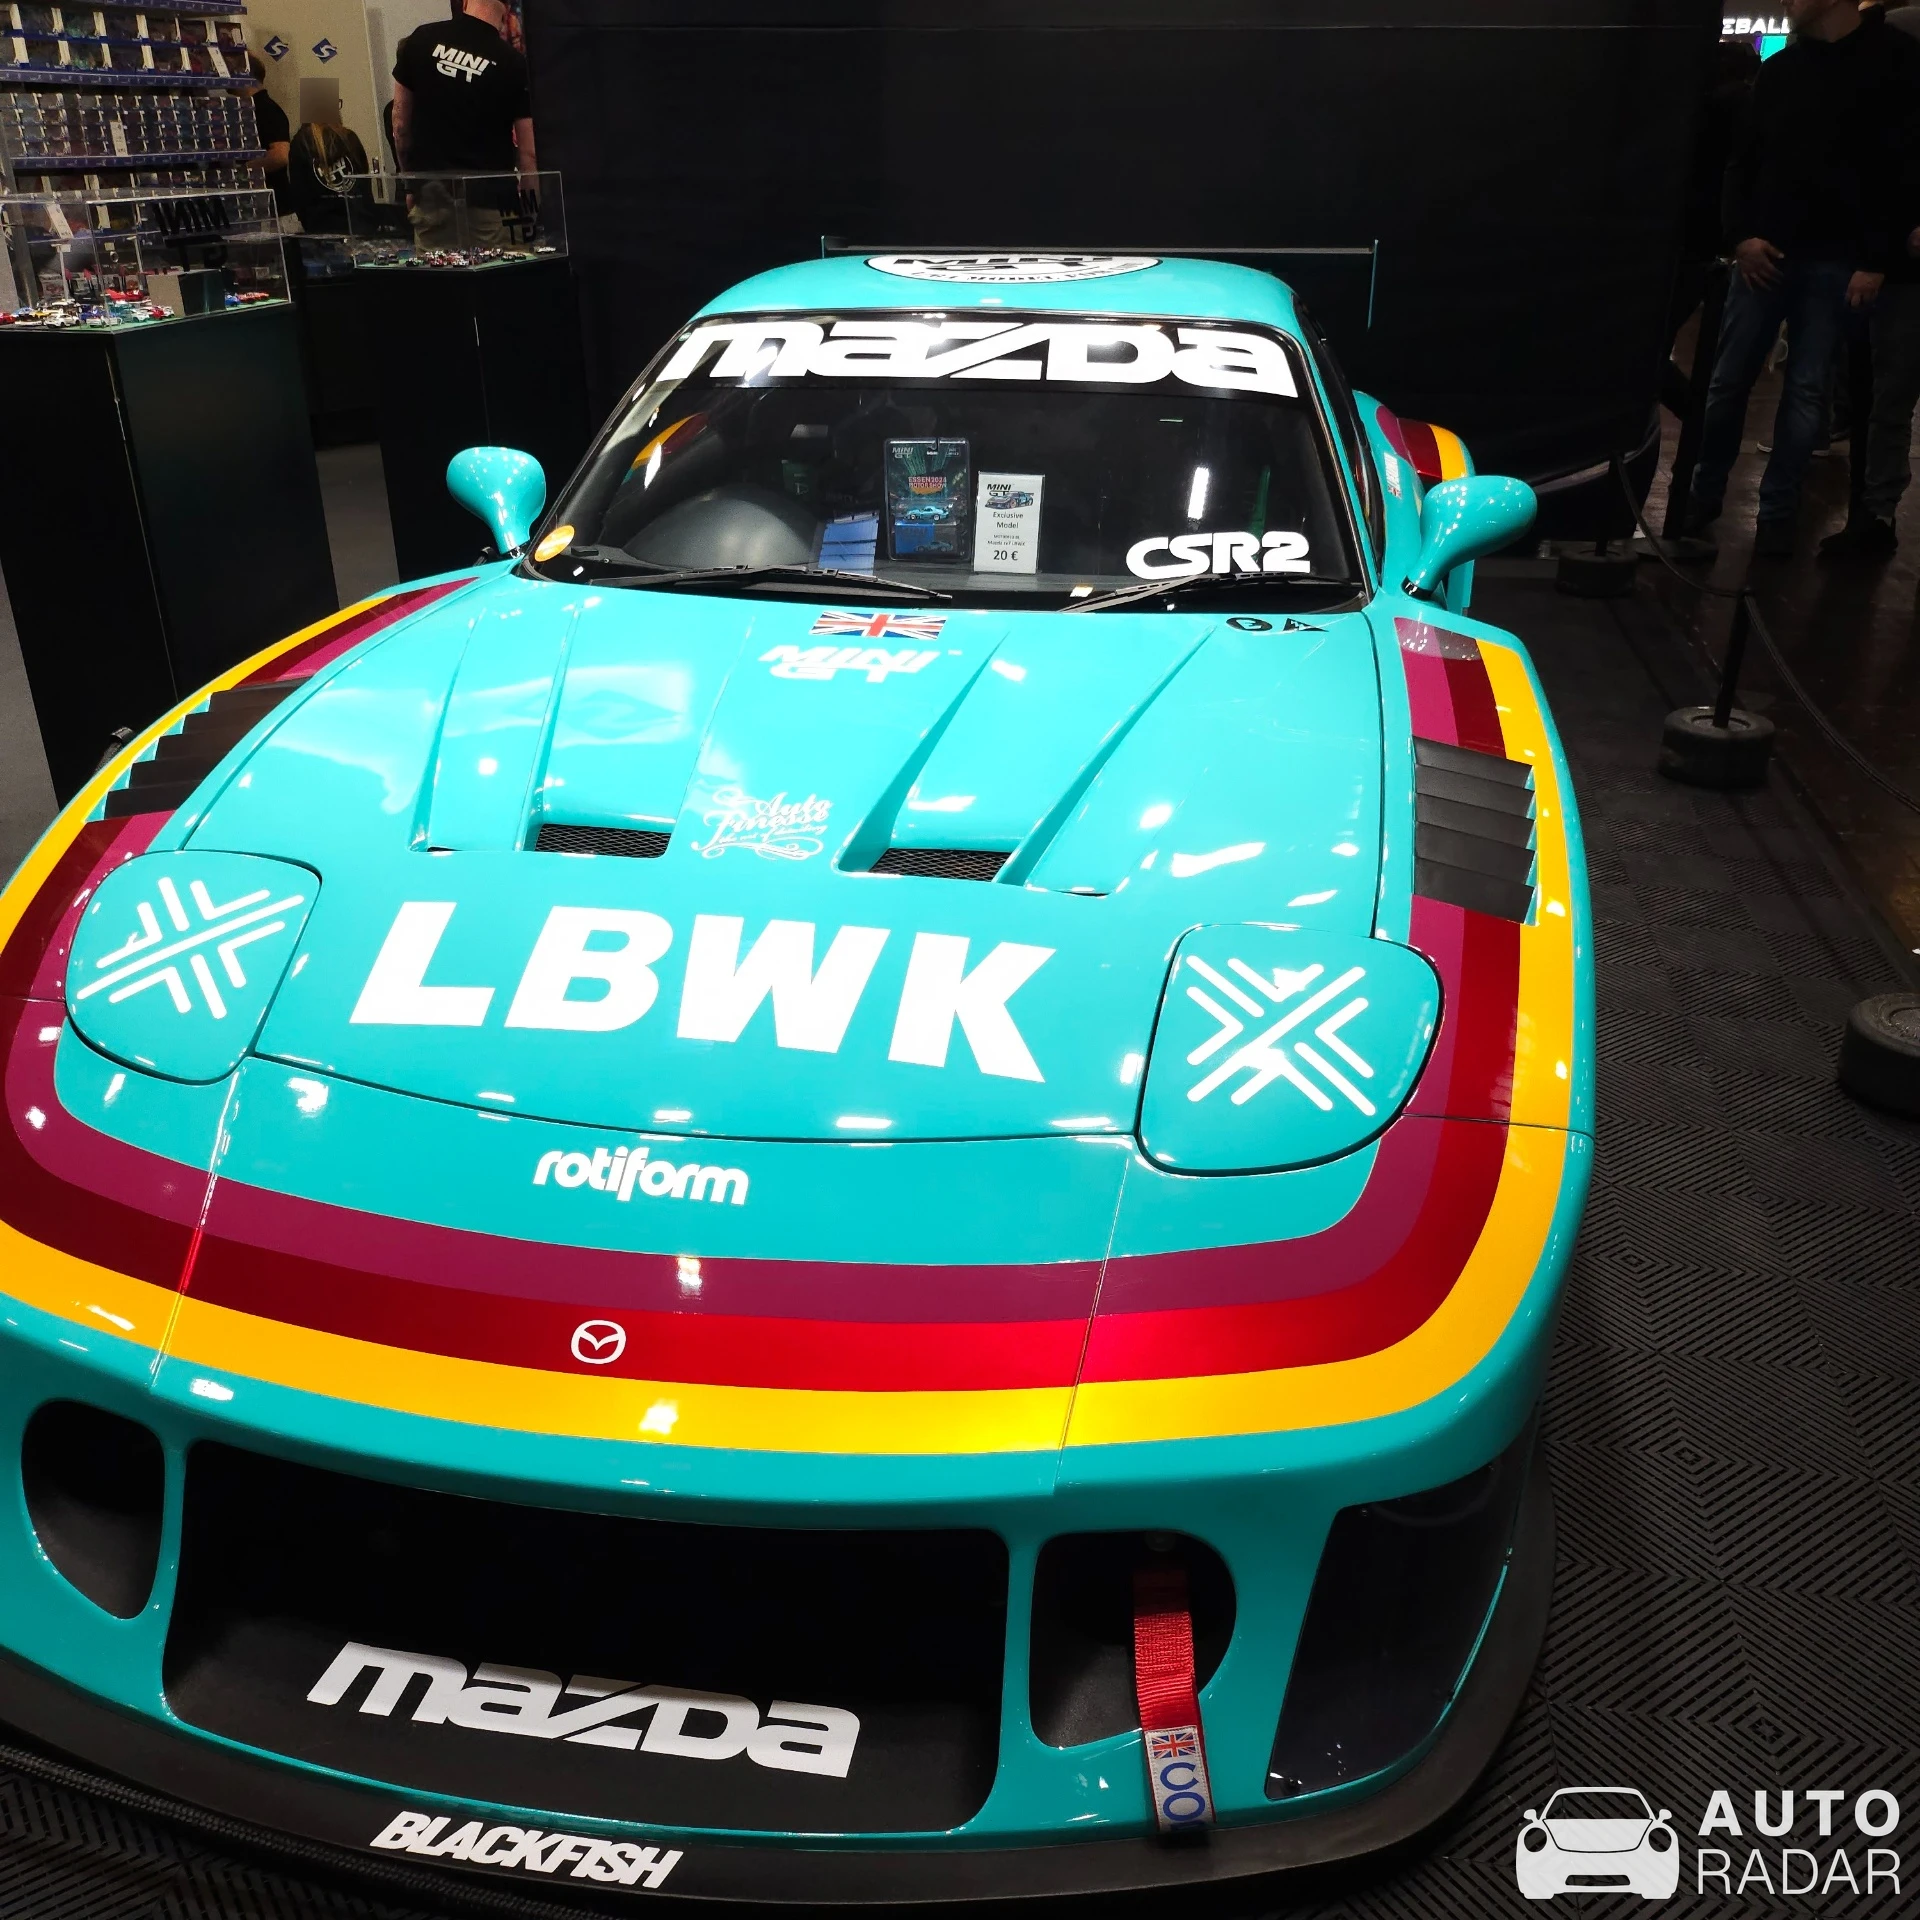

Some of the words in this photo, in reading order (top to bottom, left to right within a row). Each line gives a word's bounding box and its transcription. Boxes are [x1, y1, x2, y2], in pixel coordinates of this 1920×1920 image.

[432, 43, 490, 73] MINI
[436, 60, 482, 83] GT
[992, 511, 1024, 519] Exclusive
[993, 550, 1008, 561] 20
[1010, 550, 1019, 561] €
[1126, 531, 1310, 580] CSR2
[348, 901, 1057, 1083] LBWK
[532, 1146, 749, 1206] rotiform
[1159, 1761, 1207, 1831] CO
[370, 1810, 684, 1890] BLACKFISH
